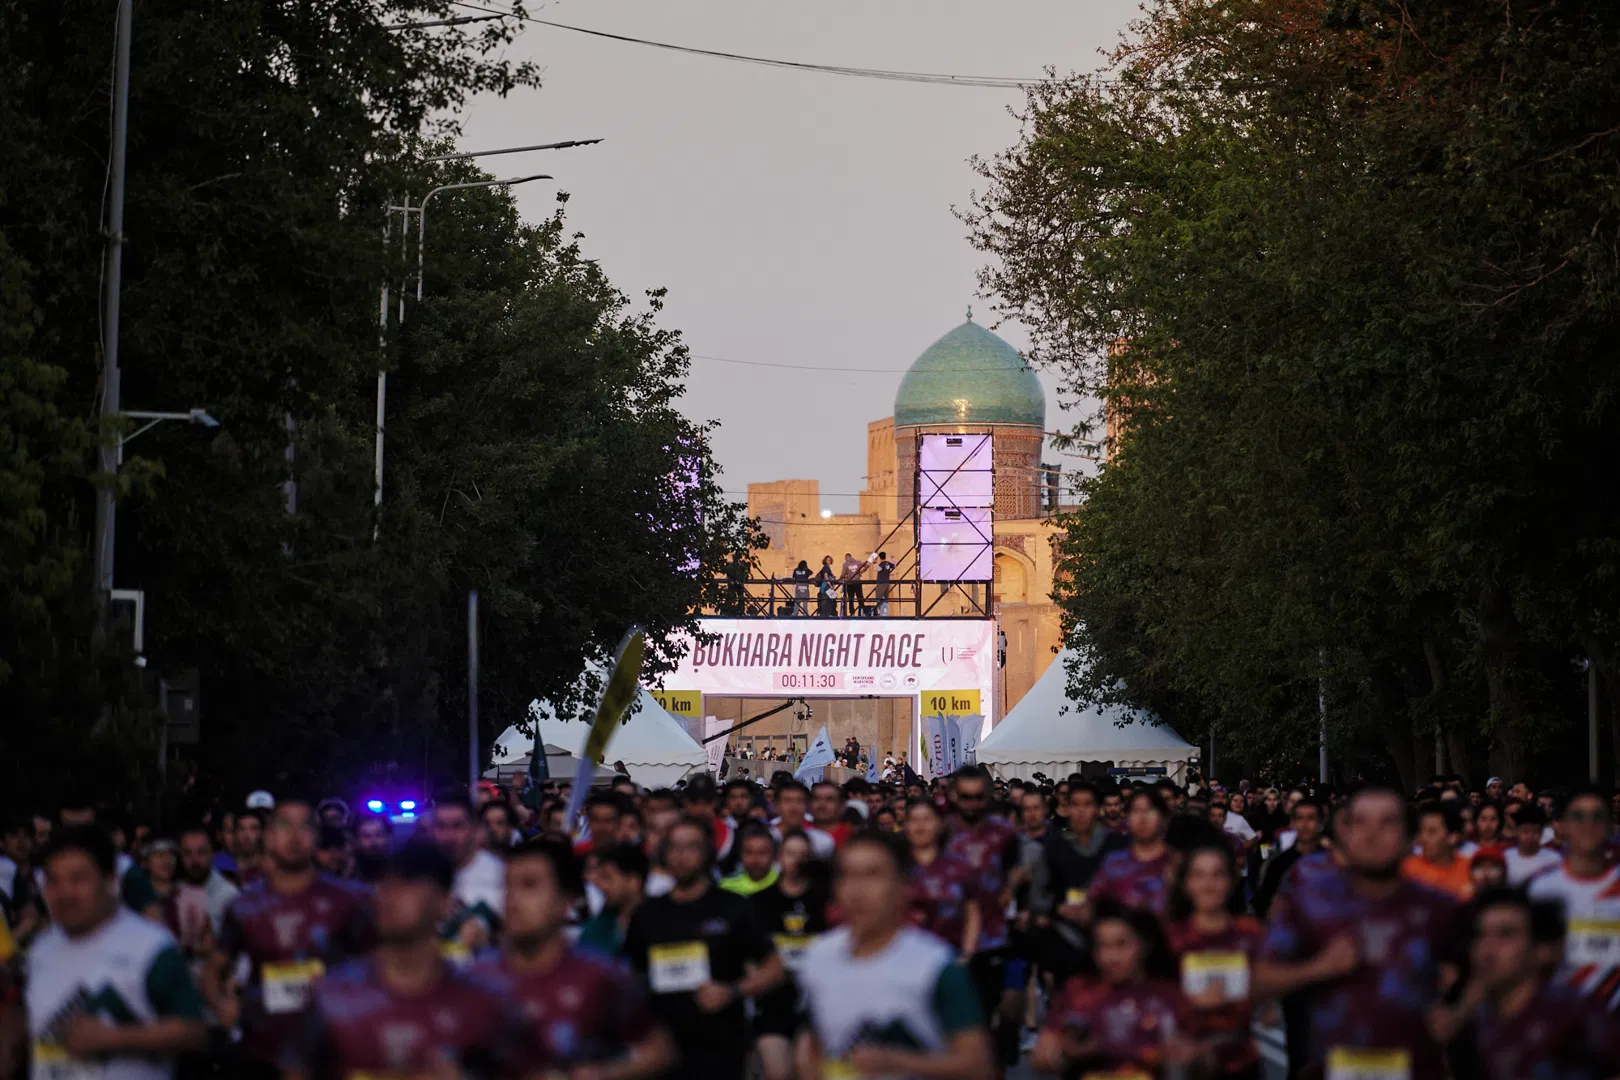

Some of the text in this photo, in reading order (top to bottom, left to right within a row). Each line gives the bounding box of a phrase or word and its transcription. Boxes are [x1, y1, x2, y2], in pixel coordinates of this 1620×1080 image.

[799, 633, 865, 667] NIGHT
[868, 633, 925, 667] RACE
[781, 674, 836, 688] 00:11:30
[654, 696, 691, 712] 0 km
[930, 696, 971, 711] 10 km
